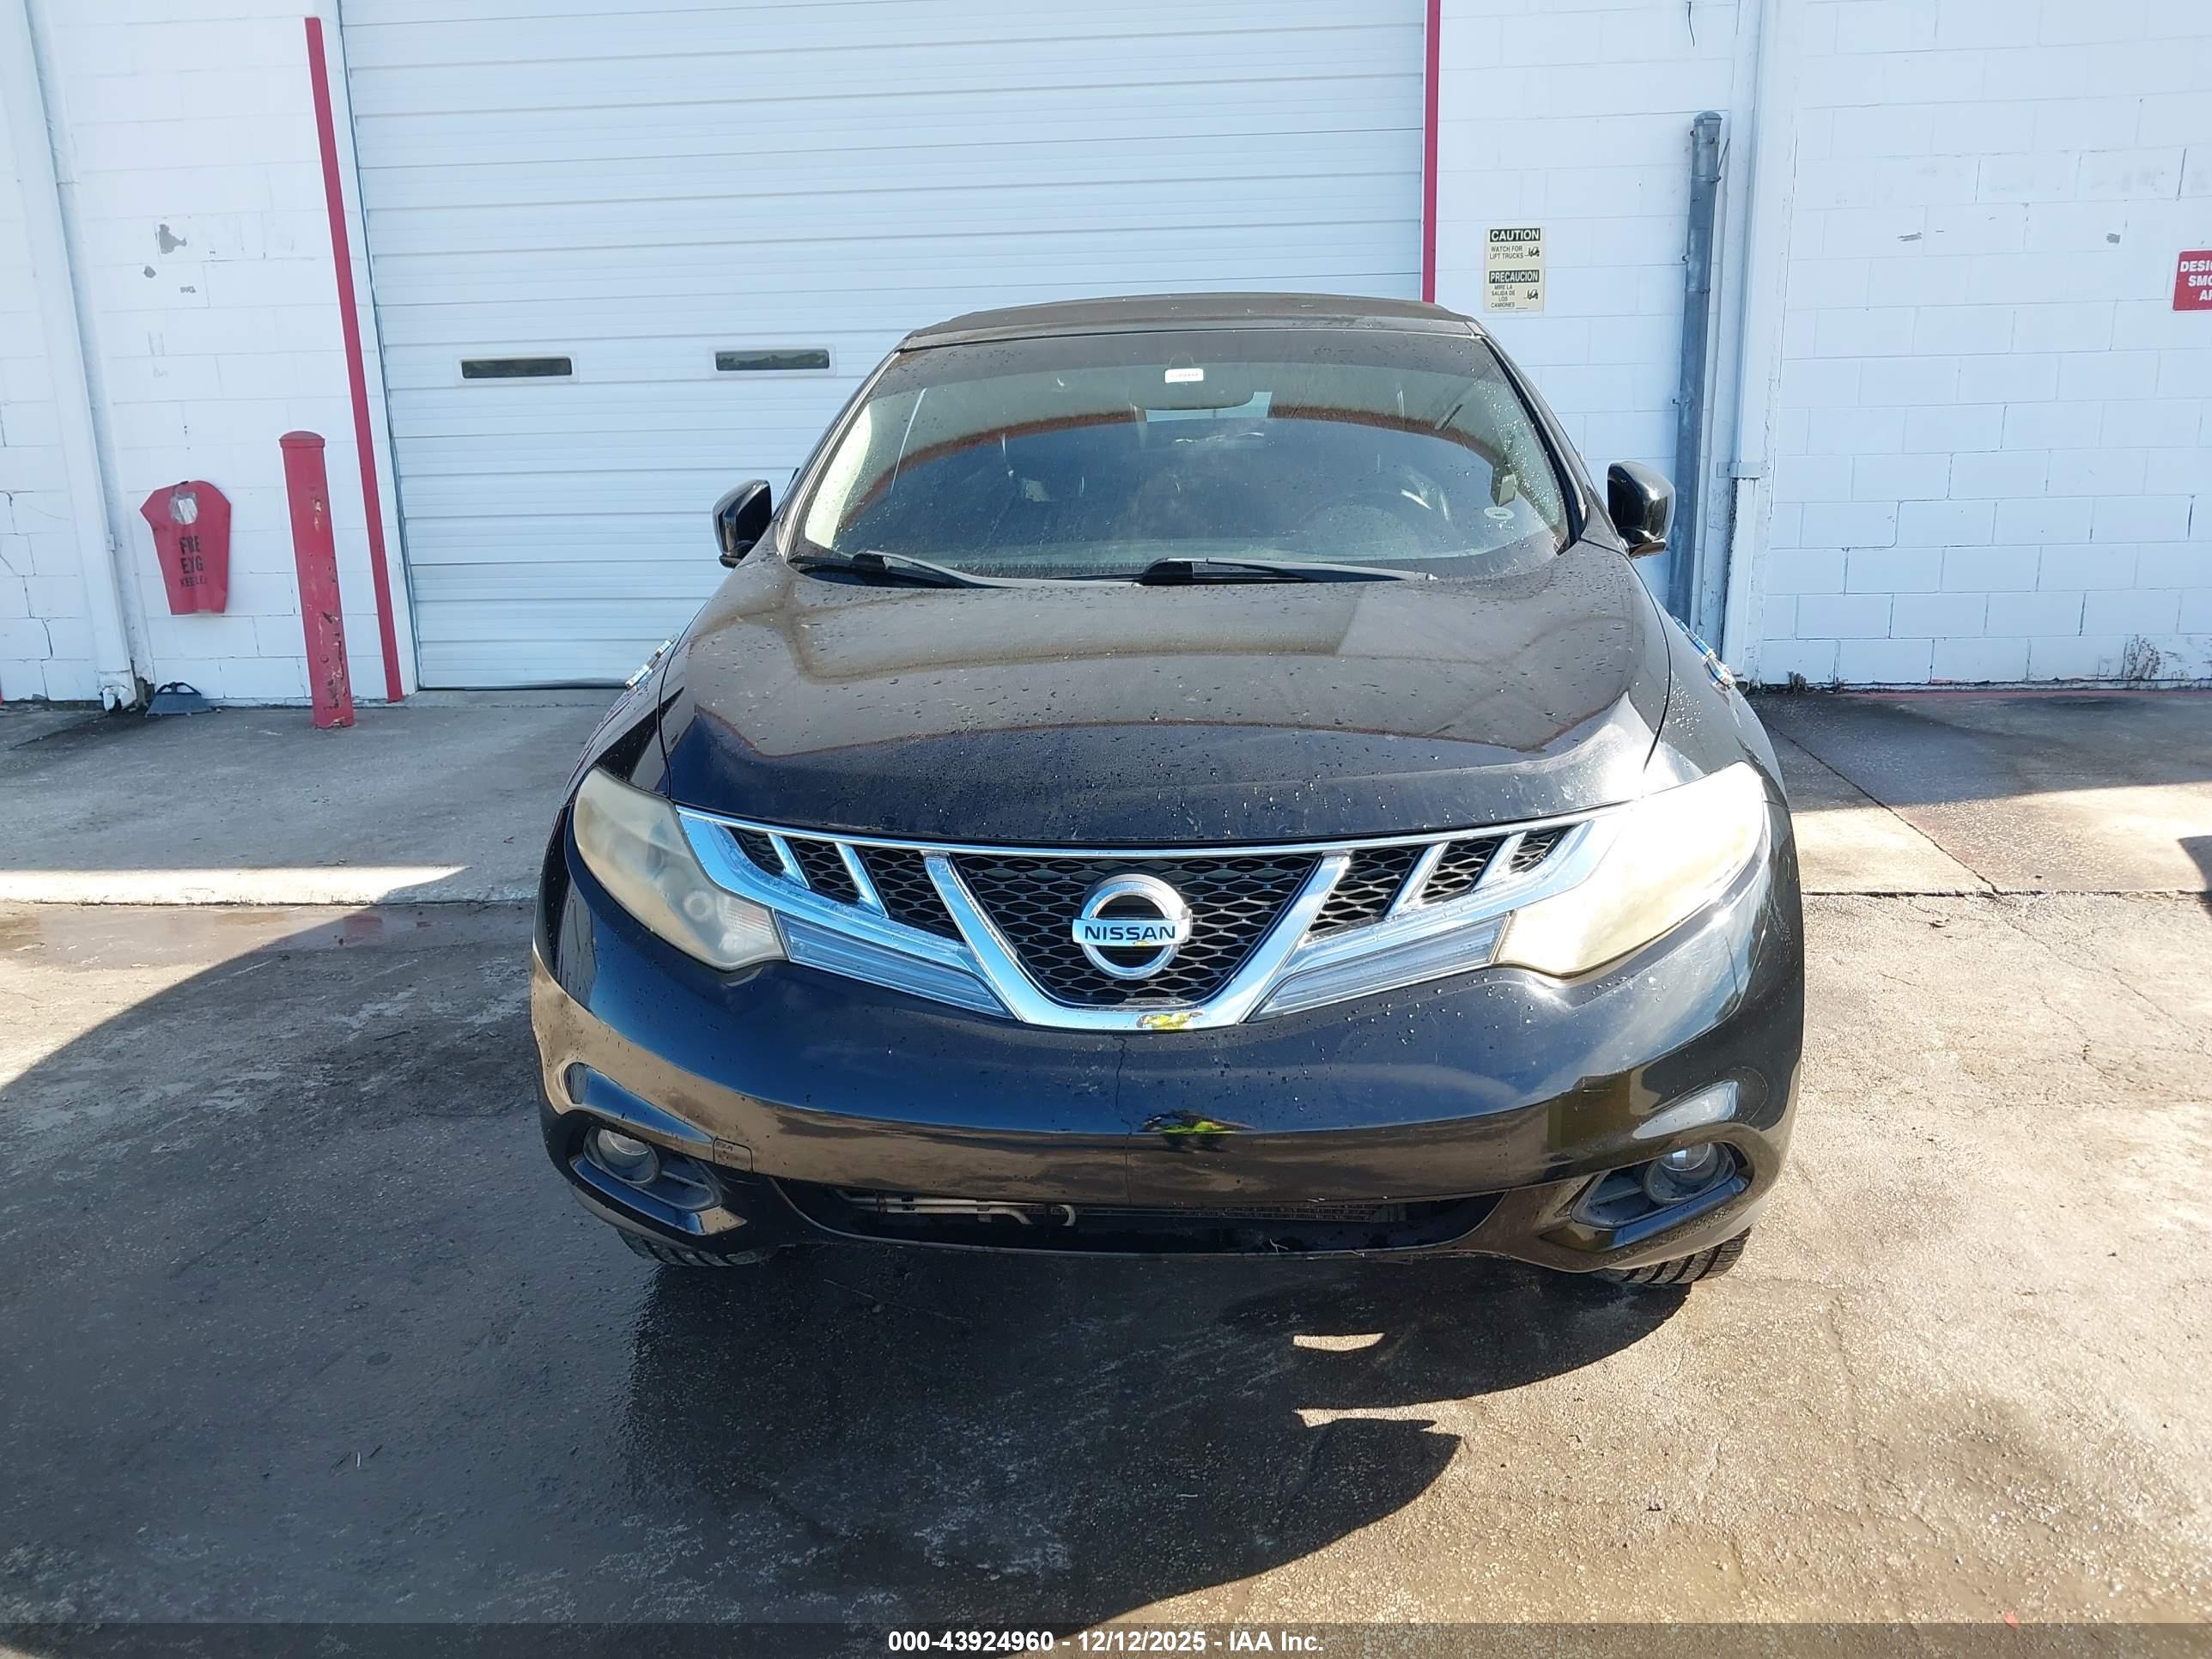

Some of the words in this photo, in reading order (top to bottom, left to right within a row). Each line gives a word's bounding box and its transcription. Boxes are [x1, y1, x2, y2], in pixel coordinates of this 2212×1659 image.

[1492, 229, 1540, 241] CAUTION
[2180, 260, 2212, 272] DESI
[1491, 270, 1539, 283] PRECAUCION
[1085, 926, 1176, 940] NISSAN
